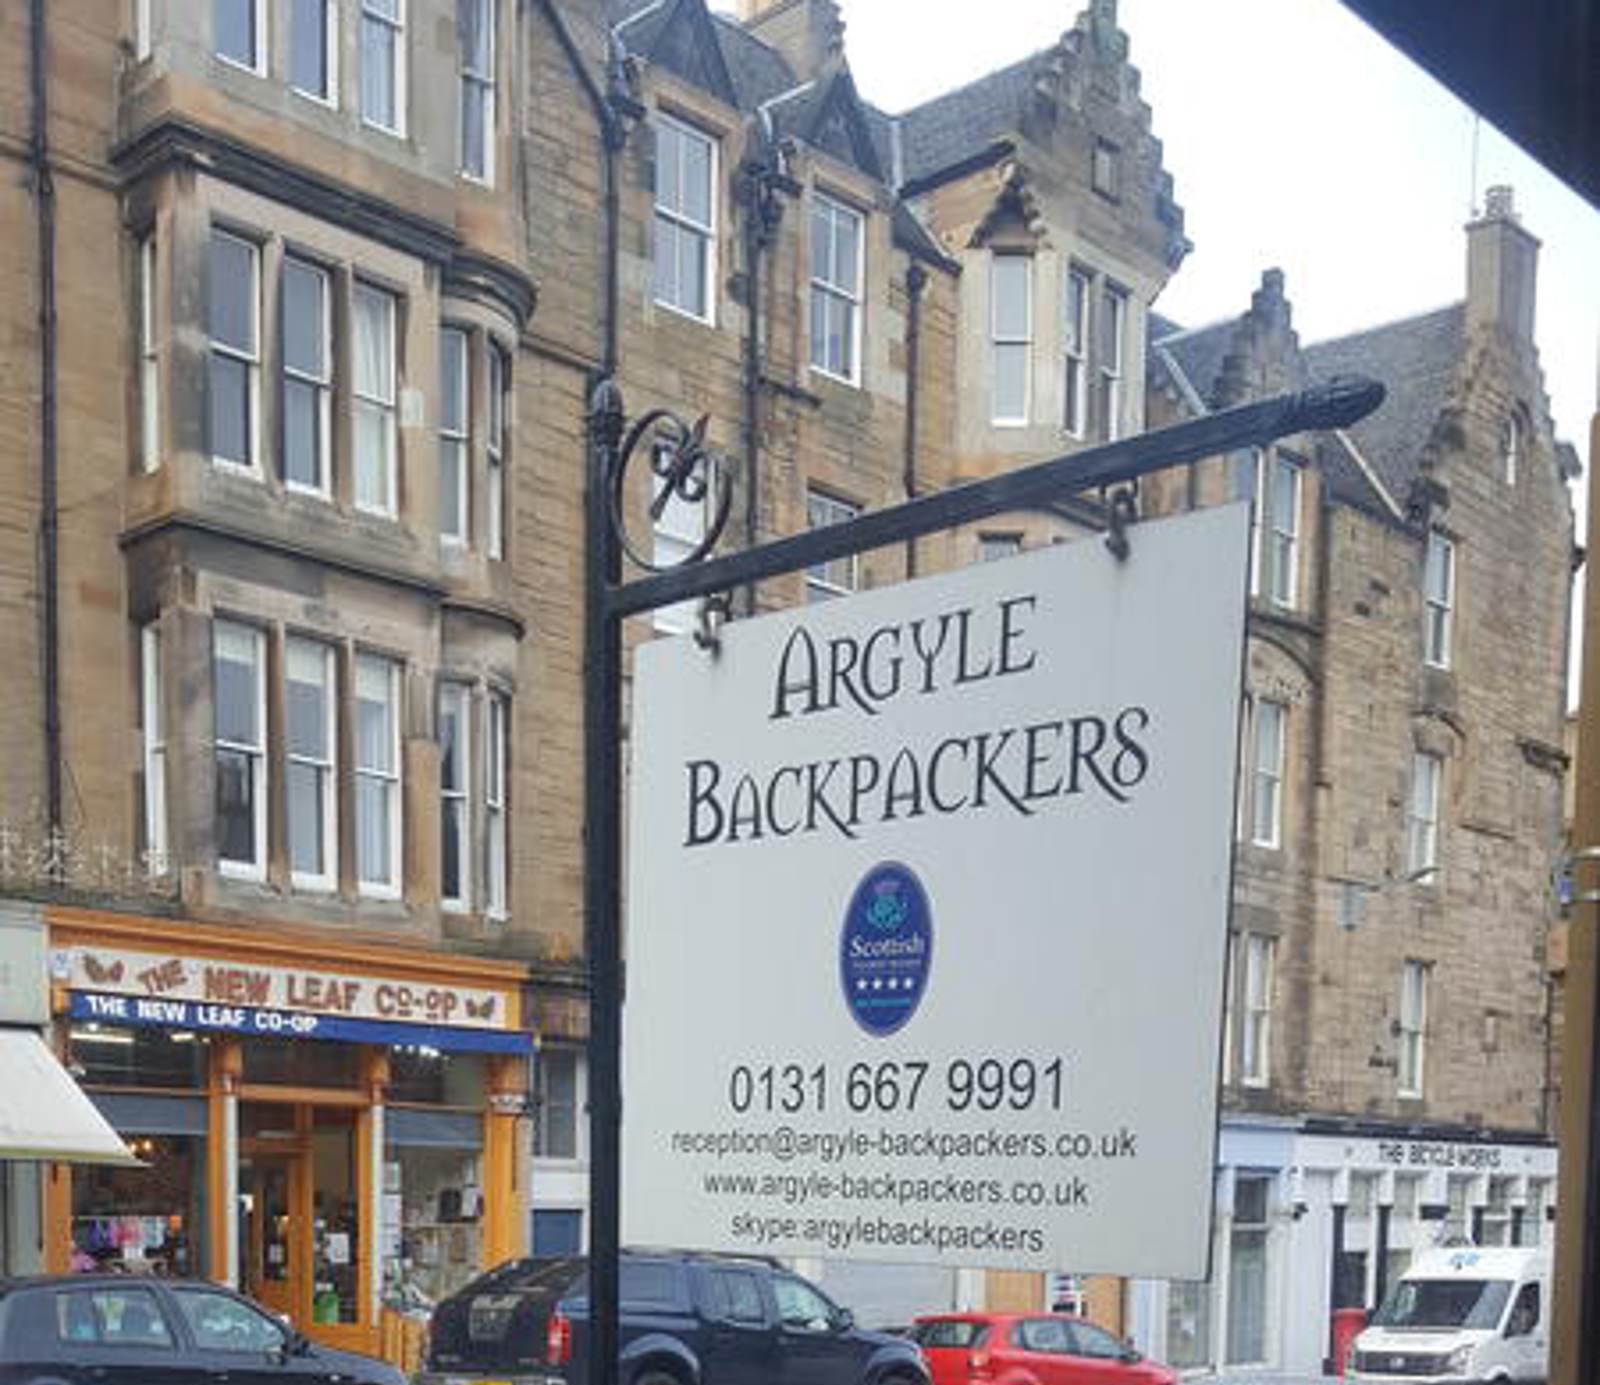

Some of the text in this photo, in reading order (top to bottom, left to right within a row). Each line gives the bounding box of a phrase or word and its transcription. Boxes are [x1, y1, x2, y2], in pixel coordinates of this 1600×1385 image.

[769, 597, 1036, 720] ARGYLE
[682, 707, 1150, 847] BACKPACKERS
[138, 960, 187, 994] THE
[205, 966, 270, 1003] NEW
[287, 975, 360, 1012] LEAF
[86, 996, 318, 1033] THE NEW LEAF CO-OP
[730, 1057, 1063, 1113] 0131 667 9991
[671, 1126, 1137, 1162] reception@argyle-backpackers.co.uk
[1379, 1143, 1402, 1163] THE
[703, 1172, 1089, 1206] www.argyle-backpackers.co.uk
